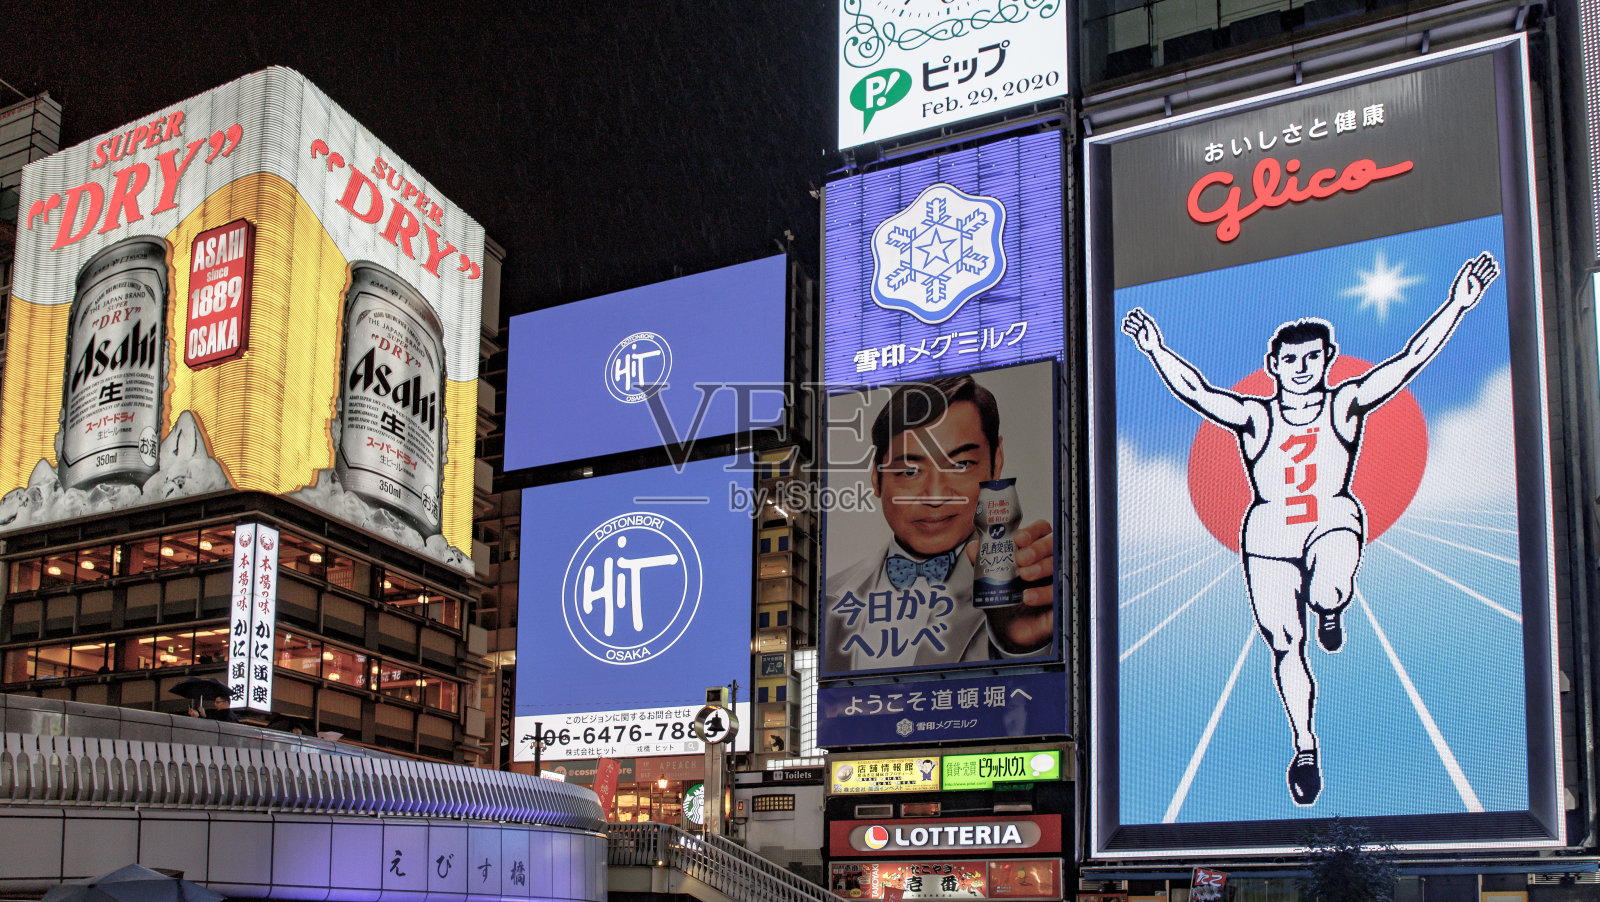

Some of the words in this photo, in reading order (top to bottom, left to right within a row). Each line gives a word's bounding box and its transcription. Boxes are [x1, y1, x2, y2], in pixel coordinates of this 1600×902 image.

[922, 39, 1010, 92] ピップ
[922, 96, 964, 118] Feb.
[968, 87, 998, 107] 29,
[1002, 70, 1060, 98] 2020
[90, 110, 184, 170] SUPER
[1204, 103, 1385, 162] おいしさと健康
[371, 156, 444, 227] SUPER
[1186, 157, 1414, 242] Glico
[193, 227, 246, 273] ASAHI
[206, 266, 228, 282] since
[103, 295, 122, 307] JAPAN
[107, 301, 128, 312] SUPER
[191, 276, 242, 319] 1889
[188, 317, 238, 360] OSAKA
[369, 318, 379, 326] THE
[382, 323, 402, 338] JAPAN
[387, 333, 408, 349] SUPER
[853, 321, 1028, 373] 雪印メグミルク
[72, 319, 156, 394] Asahi
[99, 382, 123, 406] 生
[349, 347, 435, 432] Asahi
[85, 412, 135, 434] スーパードライ
[97, 428, 120, 440] 生ビール
[381, 411, 405, 441] 生
[96, 452, 118, 467] 350ml
[140, 437, 157, 459] お酒
[366, 436, 418, 470] スーパードライ
[380, 454, 403, 472] 生ビール
[1279, 426, 1320, 526] グリコ
[380, 480, 402, 499] 350ml
[422, 492, 438, 520] お酒
[595, 516, 665, 541] DOTONBORI
[981, 540, 1014, 555] 乳酸菌
[236, 552, 250, 612] 本場の味
[258, 555, 272, 615] 本場の味
[832, 584, 954, 626] 今日から
[842, 623, 947, 659] ヘルベ
[606, 647, 651, 661] OSAKA
[501, 678, 511, 747] TSUTAYA
[845, 686, 1032, 716] ようこそ道頓堀へ
[565, 709, 691, 725] このビジョンに関するお問合せは
[916, 719, 978, 730] 雪印メグミルク
[566, 747, 617, 757] 株式会社ヒット
[655, 744, 675, 752] ヒット
[660, 760, 697, 770] APEACH
[784, 771, 812, 780] Toilets
[979, 756, 1026, 777] ピタットハウス
[895, 825, 1022, 847] LOTTERIA
[390, 850, 525, 886] えびす橋
[1196, 870, 1222, 887] たこ
